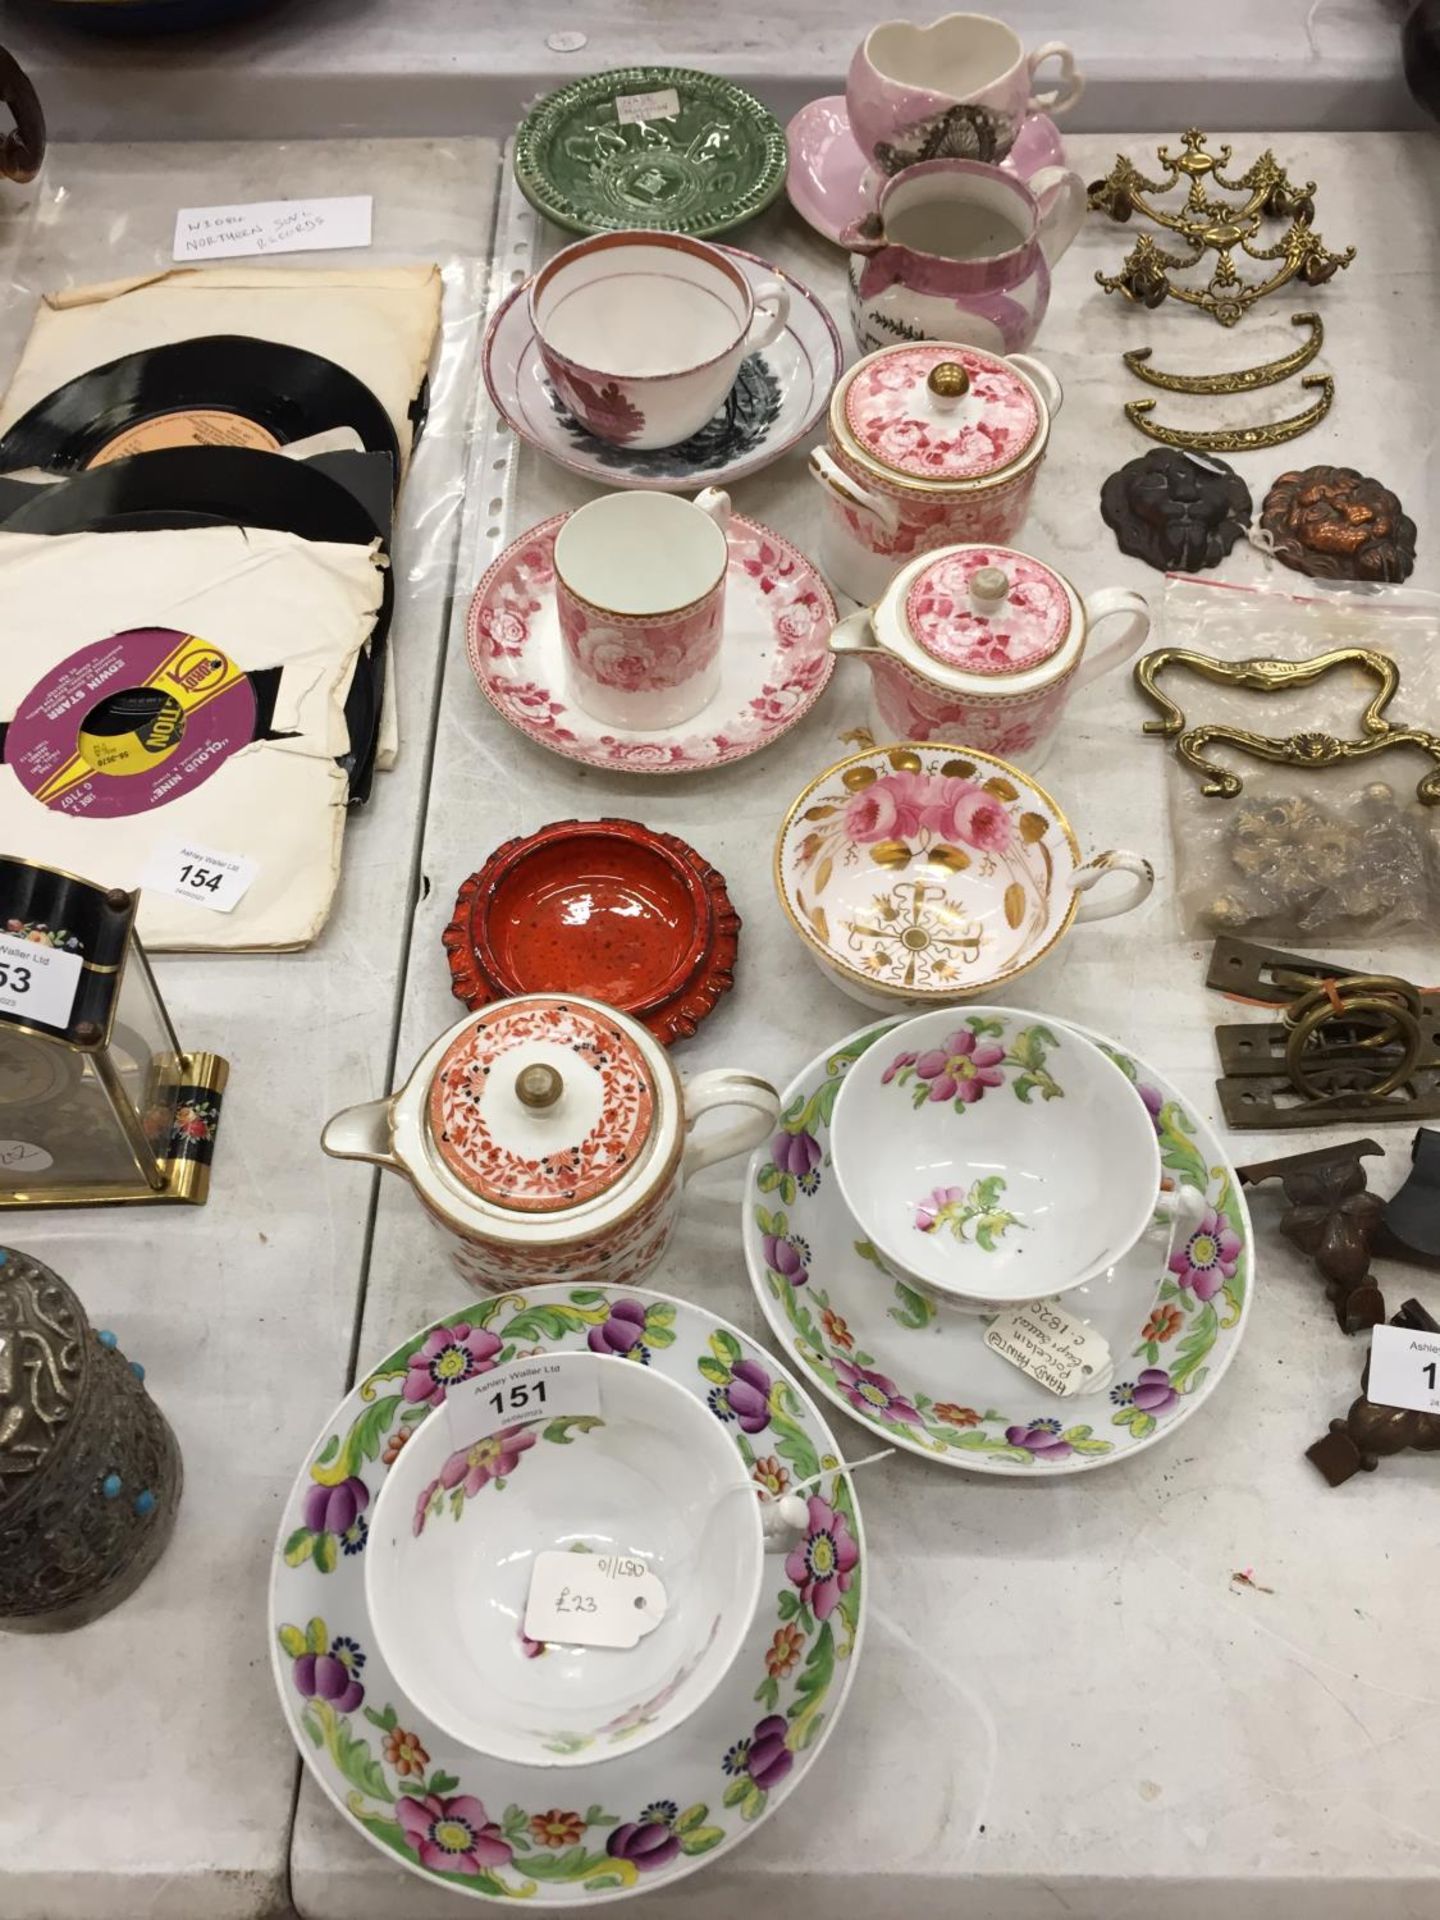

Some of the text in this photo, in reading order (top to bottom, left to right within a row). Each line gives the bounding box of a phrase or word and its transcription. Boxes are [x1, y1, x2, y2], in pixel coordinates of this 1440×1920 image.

[87, 659, 125, 690] EDWIN
[47, 689, 86, 720] STARR
[61, 789, 84, 808] 7107
[180, 848, 240, 872] Ashley Waller Ltd
[179, 864, 223, 892] 154
[32, 954, 50, 965] Ltd
[474, 1364, 561, 1395] Ashley Waller Ltd
[489, 1380, 546, 1414] 151
[555, 1587, 598, 1613] £23
